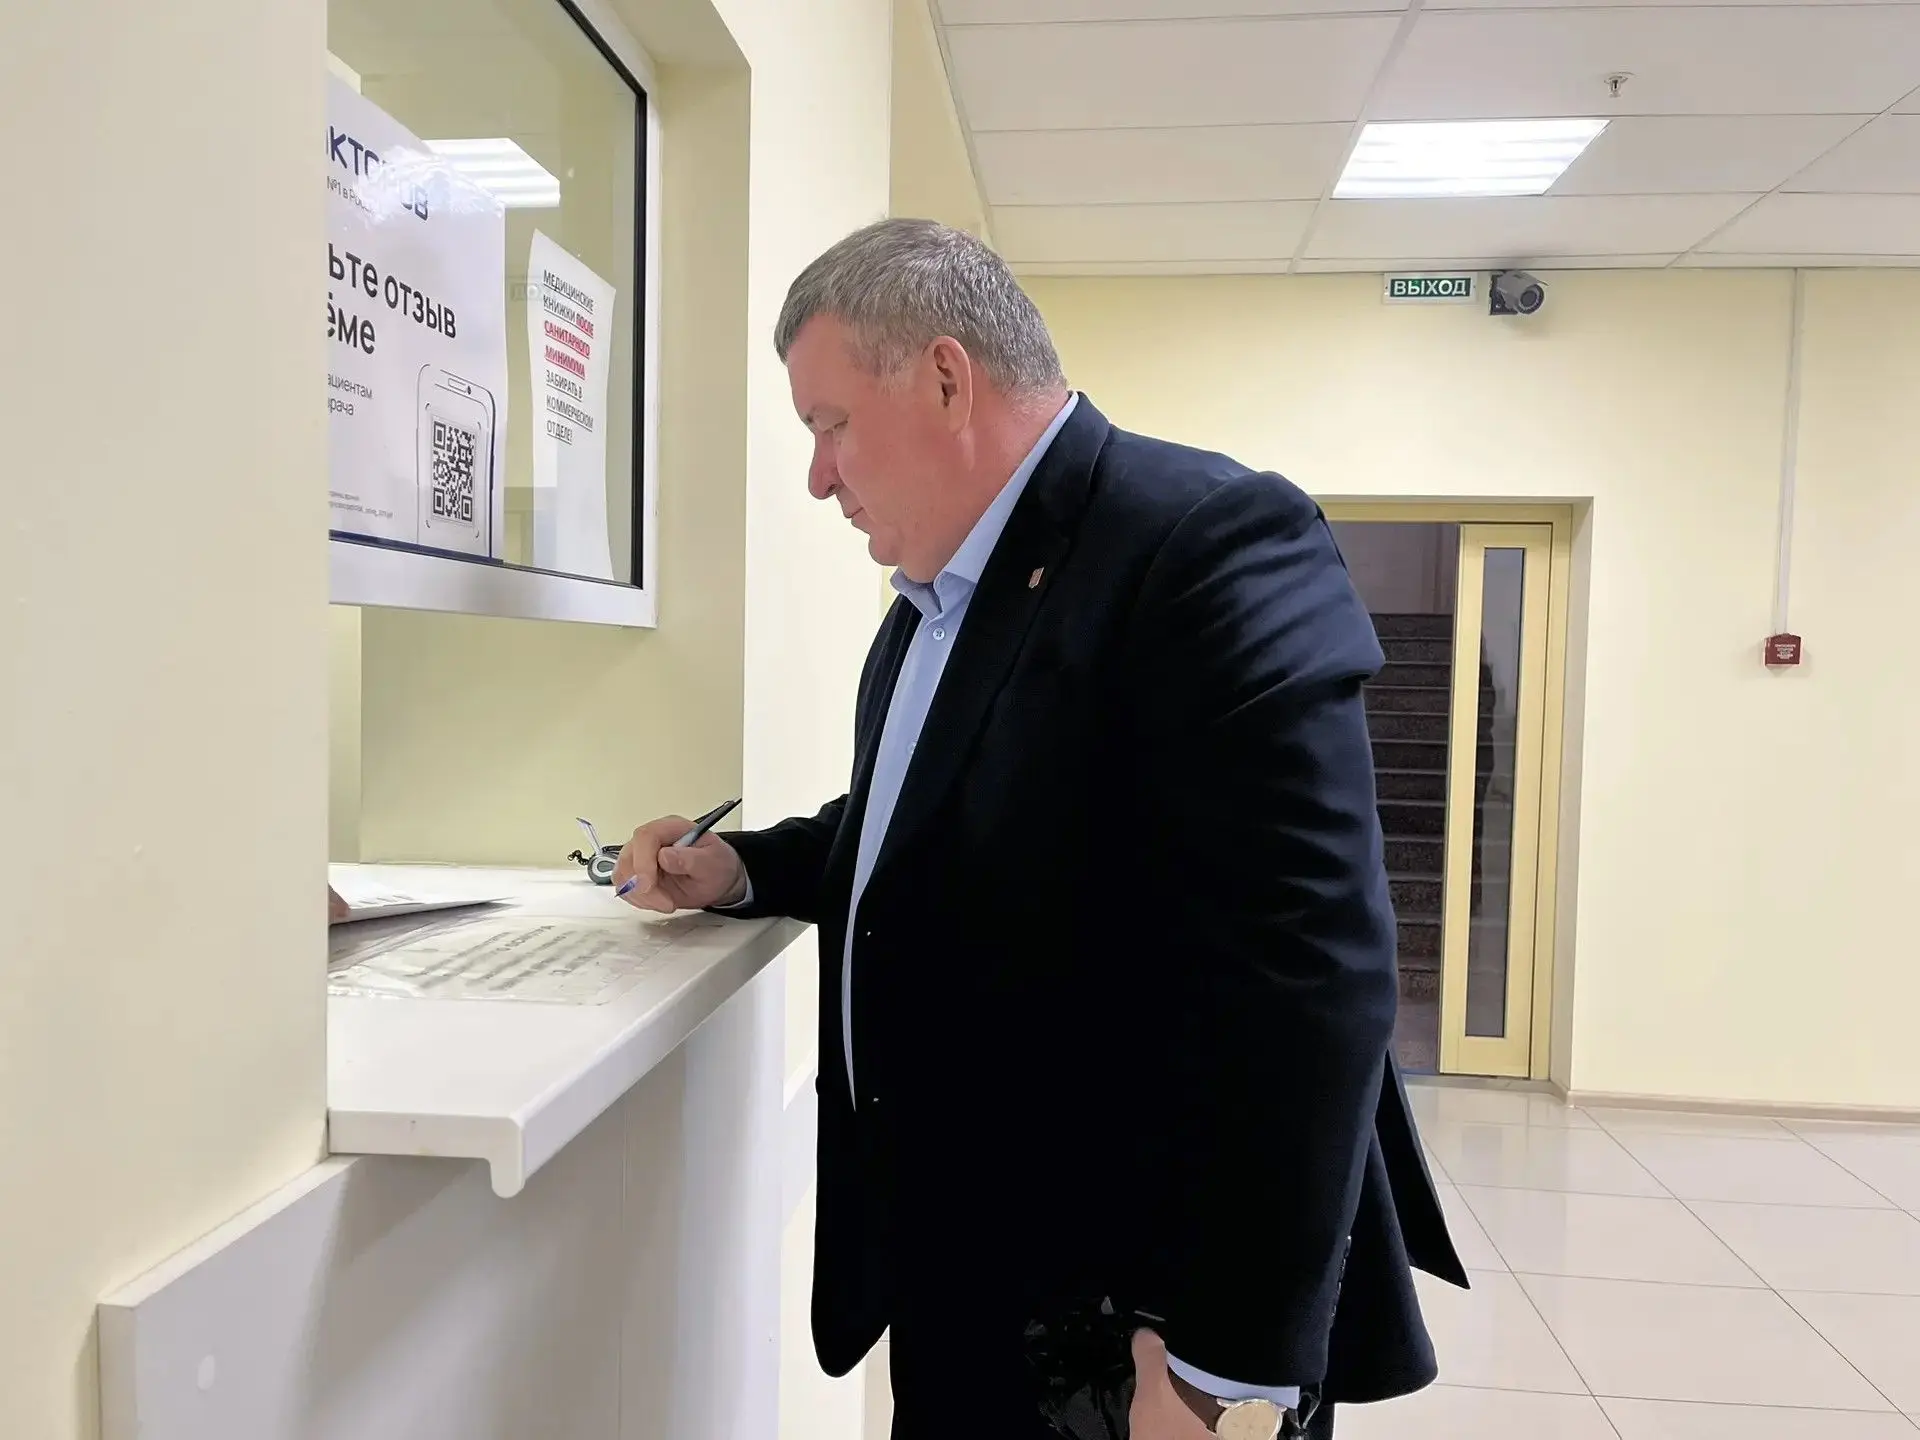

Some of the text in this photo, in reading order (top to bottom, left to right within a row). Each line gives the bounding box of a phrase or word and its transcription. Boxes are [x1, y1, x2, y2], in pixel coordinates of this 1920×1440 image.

[543, 269, 594, 313] МЕДИЦИНСКИЕ
[1393, 279, 1467, 296] ВЫХОД
[384, 275, 456, 339] отзыв
[543, 294, 576, 323] КНИЖКИ
[544, 320, 591, 357] САНИТАРНОГО
[545, 344, 586, 379] МИНИМУМА
[546, 369, 578, 397] ЗАБИРАТЬ
[546, 394, 594, 430] КОММЕРЧЕСКОМ
